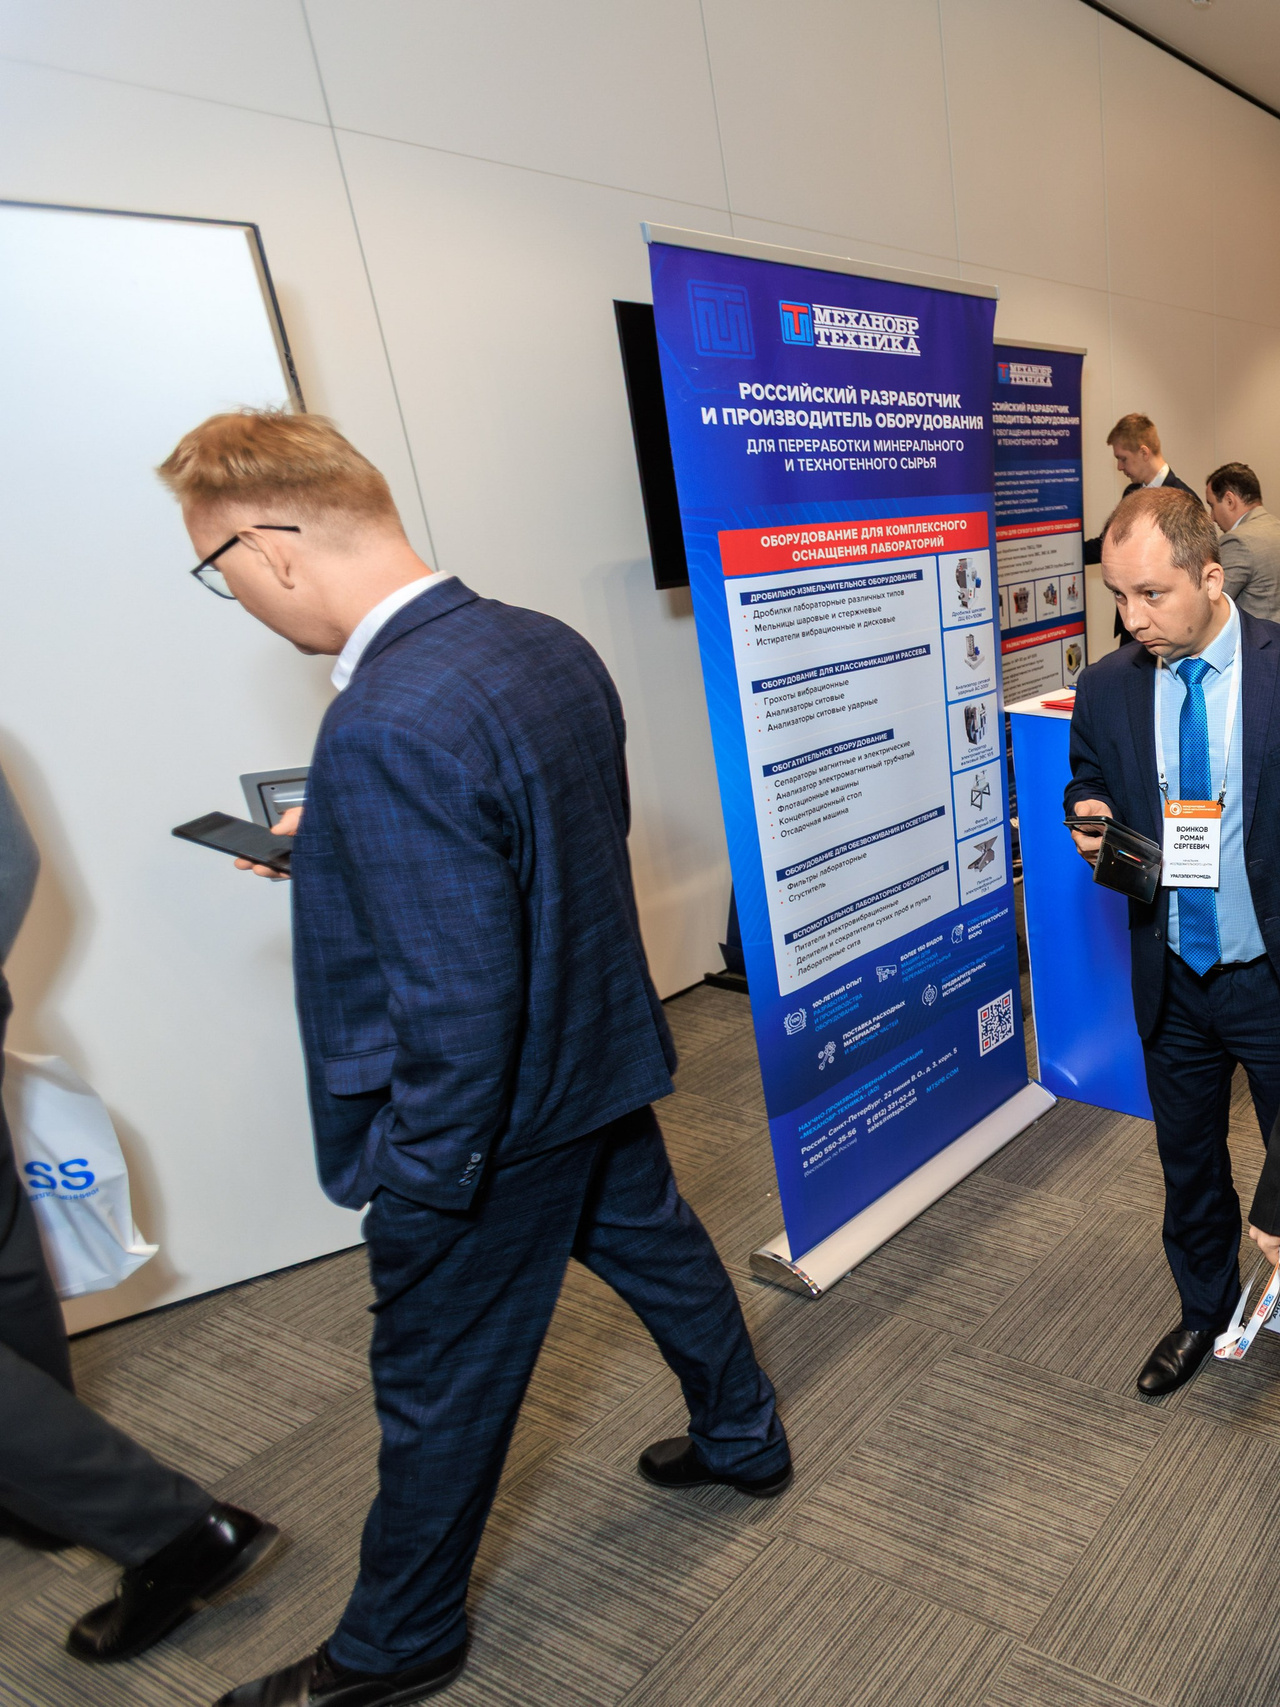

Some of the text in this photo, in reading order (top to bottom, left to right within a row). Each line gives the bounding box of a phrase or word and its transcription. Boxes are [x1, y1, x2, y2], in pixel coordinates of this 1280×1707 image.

[813, 307, 920, 335] МЕХАНОБР
[815, 329, 920, 354] ТЕХНИКА
[738, 382, 962, 409] РОССИЙСКИЙ РАЗРАБОТЧИК
[992, 401, 1026, 412] СИЙСКИЙ
[701, 406, 984, 431] И ПРОИЗВОДИТЕЛЬ ОБОРУДОВАНИЯ
[747, 439, 964, 455] ДЛЯ ПЕРЕРАБОТКИ МИНЕРАЛЬНОГО
[785, 457, 937, 472] И ТЕХНОГЕННОГО СЫРЬЯ
[761, 520, 967, 548] ОБОРУДОВАНИЕ ДЛЯ КОМПЛЕКСНОГО
[792, 535, 944, 562] ОСНАЩЕНИЯ ЛАБОРАТОРИЙ
[750, 572, 917, 603] ДРОБИЛЬНО-ИЗМЕЛЬЧИТЕЛЬНОЕ ОБОРУДОВАНИЕ
[753, 590, 905, 620] Дробилки лабораторные различных типов
[754, 620, 795, 633] Мельницы
[796, 613, 830, 626] шаровые
[837, 606, 882, 620] стержневые
[756, 632, 800, 646] Истиратели
[801, 623, 856, 638] вибрационные
[863, 615, 896, 629] дисковые
[761, 669, 818, 690] ОБОРУДОВАНИЕ
[819, 666, 834, 677] ДЛЯ
[834, 653, 895, 673] КЛАССИФИКАЦИИ
[901, 647, 927, 658] РАССЕВА
[763, 679, 850, 706] Грохоты вибрационные
[765, 692, 845, 719] Анализаторы ситовые
[767, 697, 879, 732] Анализаторы ситовые ударные
[771, 732, 888, 773] ОБОГАТИТЕЛЬНОЕ ОБОРУДОВАНИЕ
[774, 768, 817, 788] Сепараторы
[819, 756, 856, 773] магнитные
[863, 740, 911, 760] электрические
[776, 750, 915, 801] Анализатор электромагнитный трубчатый
[777, 780, 859, 813] Флотационные машины
[778, 791, 863, 826] Концентрационный стол
[780, 807, 849, 838] Отсадочная машина
[785, 851, 834, 877] ОБОРУДОВАНИЕ
[834, 845, 848, 856] ДЛЯ
[848, 825, 900, 850] ОБЕЗВОЖИВАНИЯ
[905, 810, 938, 829] ОСВЕТЛЕНИЯ
[787, 852, 868, 890] Фильтры лабораторные
[788, 882, 827, 902] Сгуститель
[792, 905, 854, 940] ВСПОМОГАТЕЛЬНОЕ
[855, 885, 902, 910] ЛАБОРАТОРНОЕ
[902, 864, 945, 889] ОБОРУДОВАНИЕ
[794, 900, 899, 953] Питатели электровибрационные
[796, 945, 829, 966] Делители
[835, 921, 875, 945] сократители
[875, 914, 893, 926] сухих
[894, 905, 909, 918] проб
[915, 895, 932, 908] пульп
[797, 939, 862, 976] Лабораторные сита
[812, 976, 863, 1009] 100-ЛЕТНИЙ ОПЫТ
[842, 1020, 873, 1040] ПОСТАВКА
[883, 1090, 892, 1100] 22
[809, 1151, 823, 1165] 800
